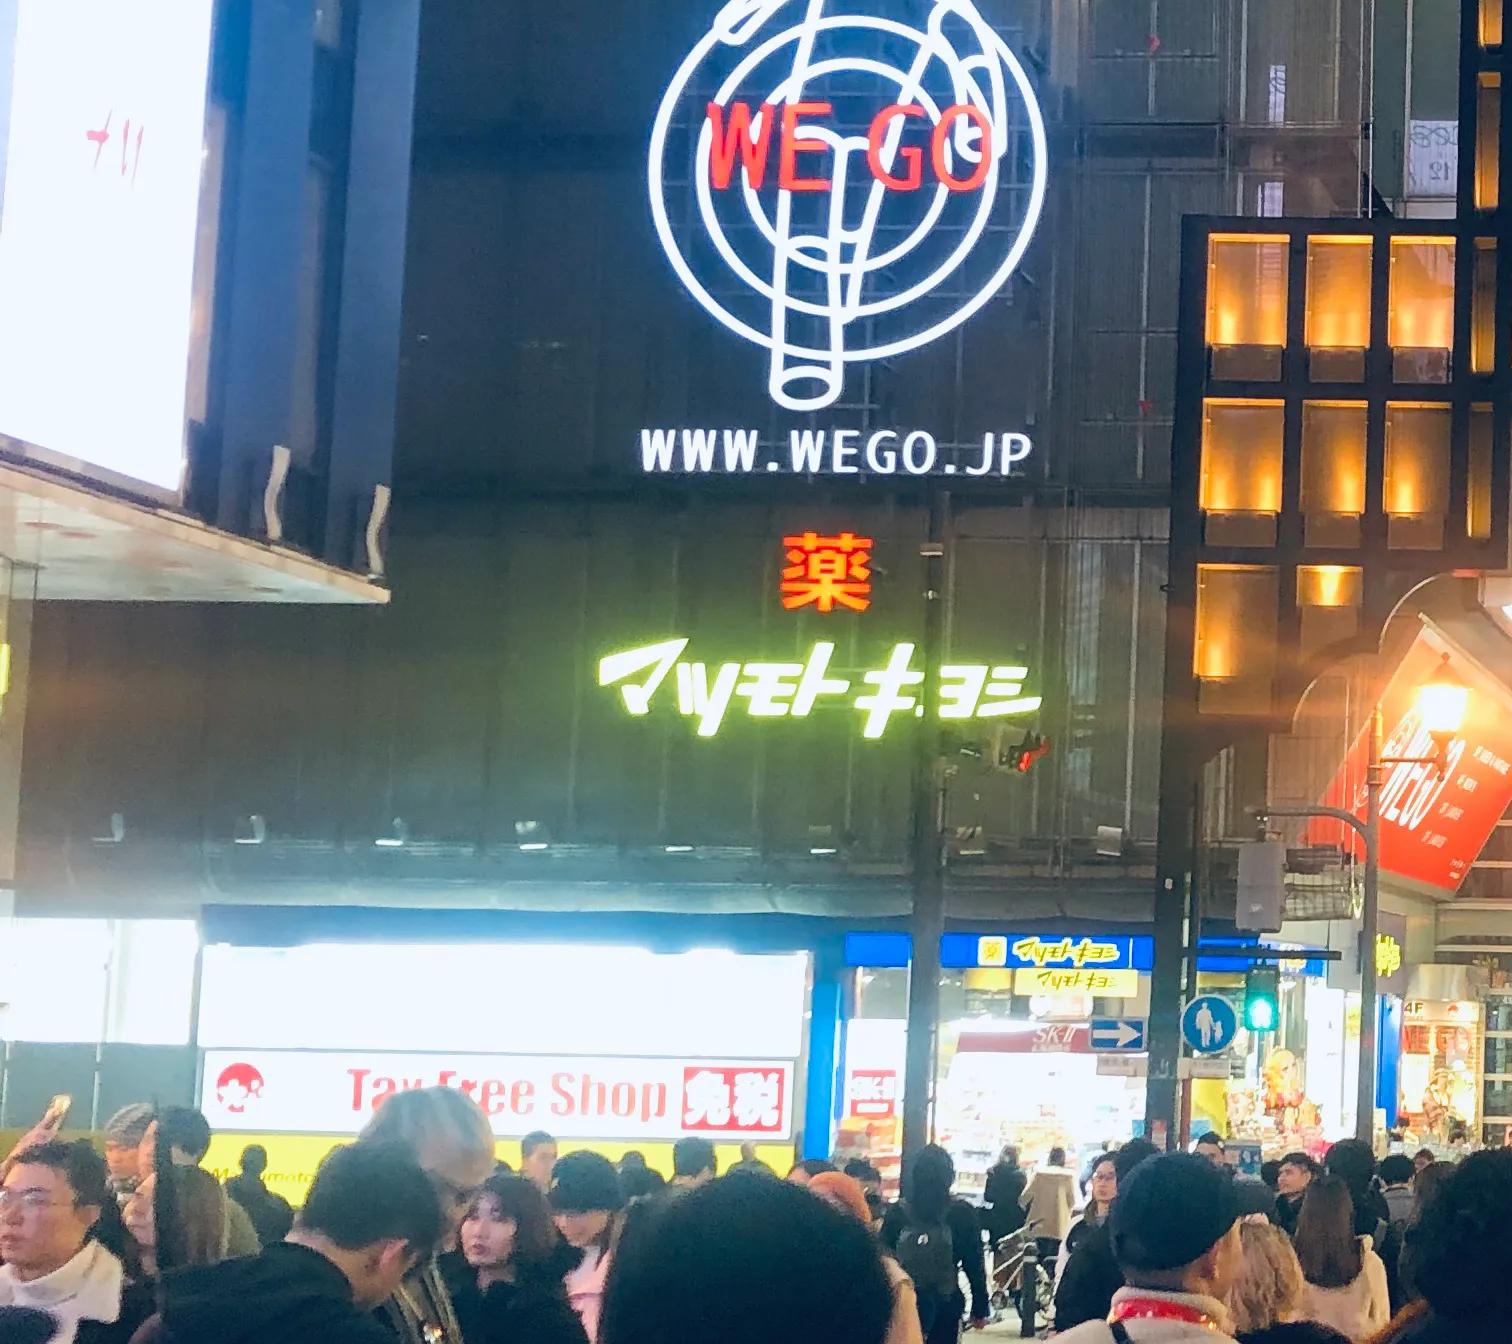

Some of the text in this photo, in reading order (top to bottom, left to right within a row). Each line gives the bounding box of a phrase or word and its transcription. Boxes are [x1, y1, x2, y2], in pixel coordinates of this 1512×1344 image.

[639, 427, 1034, 477] WWW.WEGO.JP
[780, 529, 875, 614] 薬
[598, 635, 1043, 739] マツモトキヨシ
[1403, 1002, 1424, 1014] 4F
[550, 1072, 667, 1122] Shop
[684, 1069, 782, 1130] 免税
